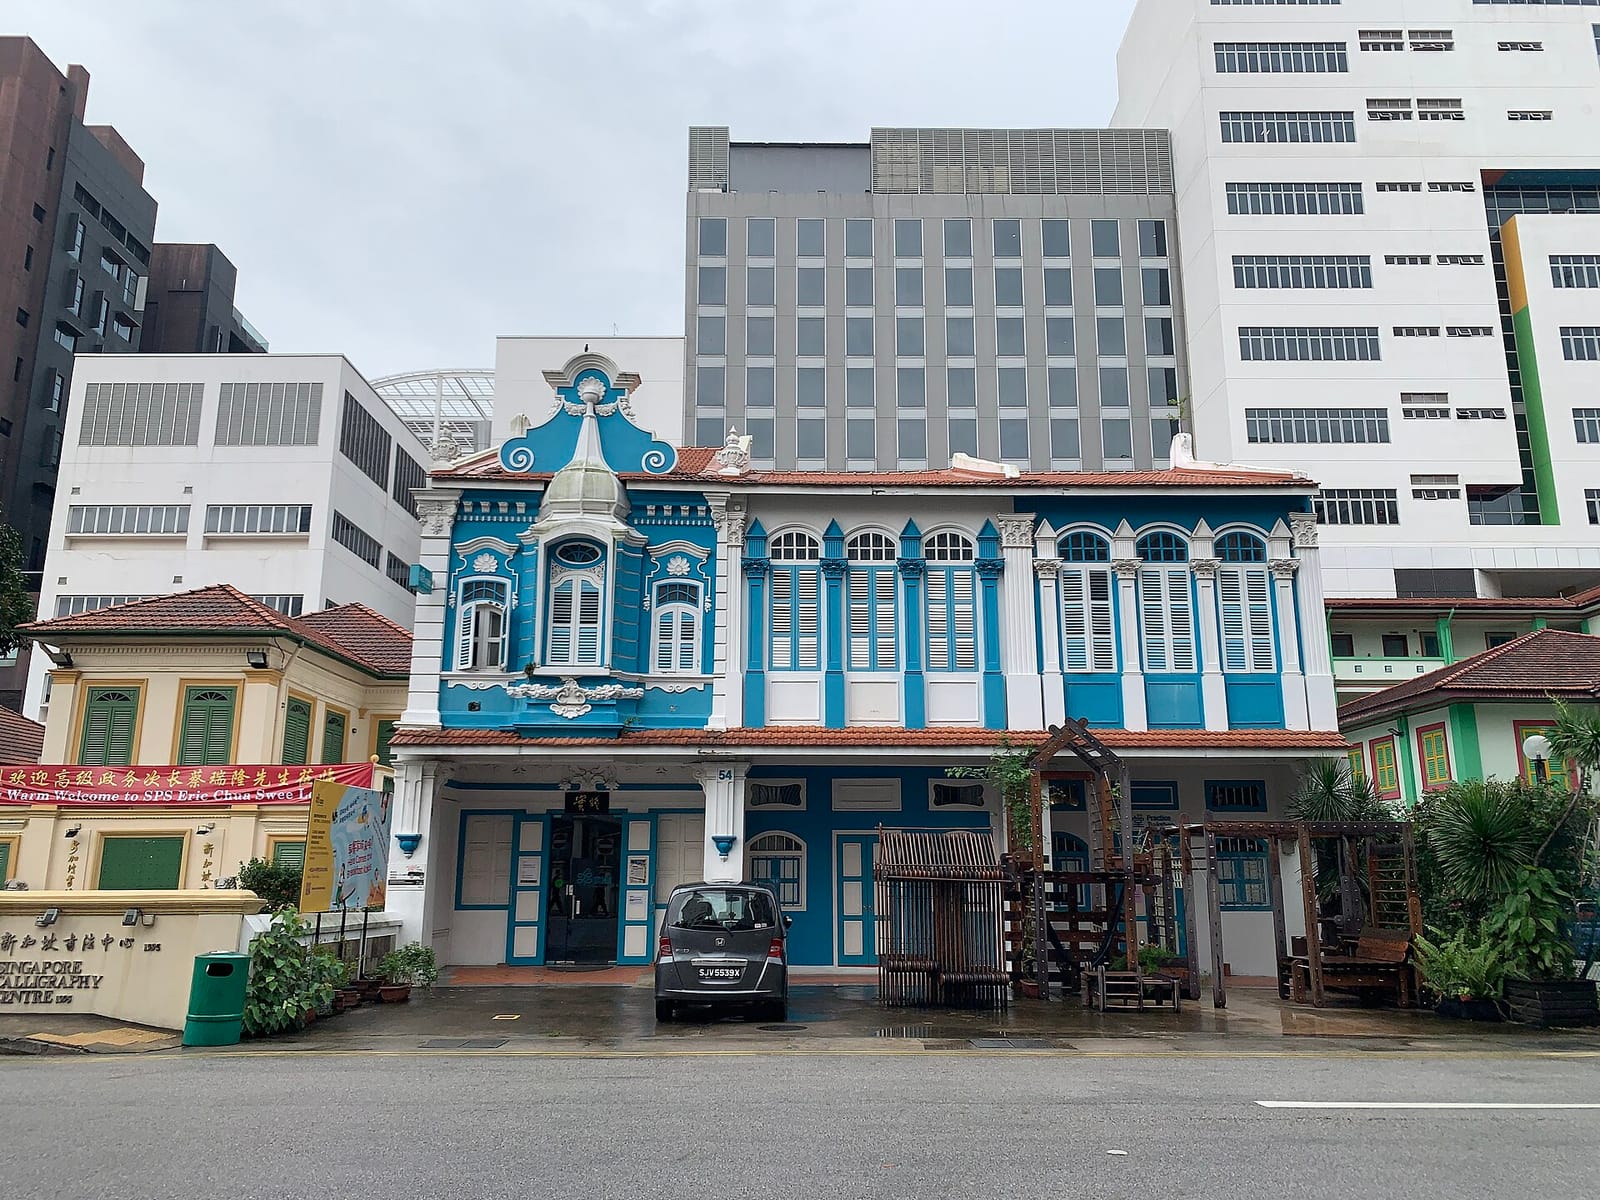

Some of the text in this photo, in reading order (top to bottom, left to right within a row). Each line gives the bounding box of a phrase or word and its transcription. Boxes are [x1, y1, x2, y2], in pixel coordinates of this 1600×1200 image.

[718, 769, 732, 780] 54
[7, 789, 50, 801] Warm
[55, 790, 119, 801] Welcome
[124, 791, 139, 802] to
[143, 789, 173, 802] SPS
[177, 789, 209, 801] Eric
[213, 789, 251, 801] Chua
[255, 788, 293, 800] Swee
[0, 961, 83, 975] SINGAPORE
[698, 968, 740, 977] SJV5539X
[0, 990, 53, 1005] ENTRE
